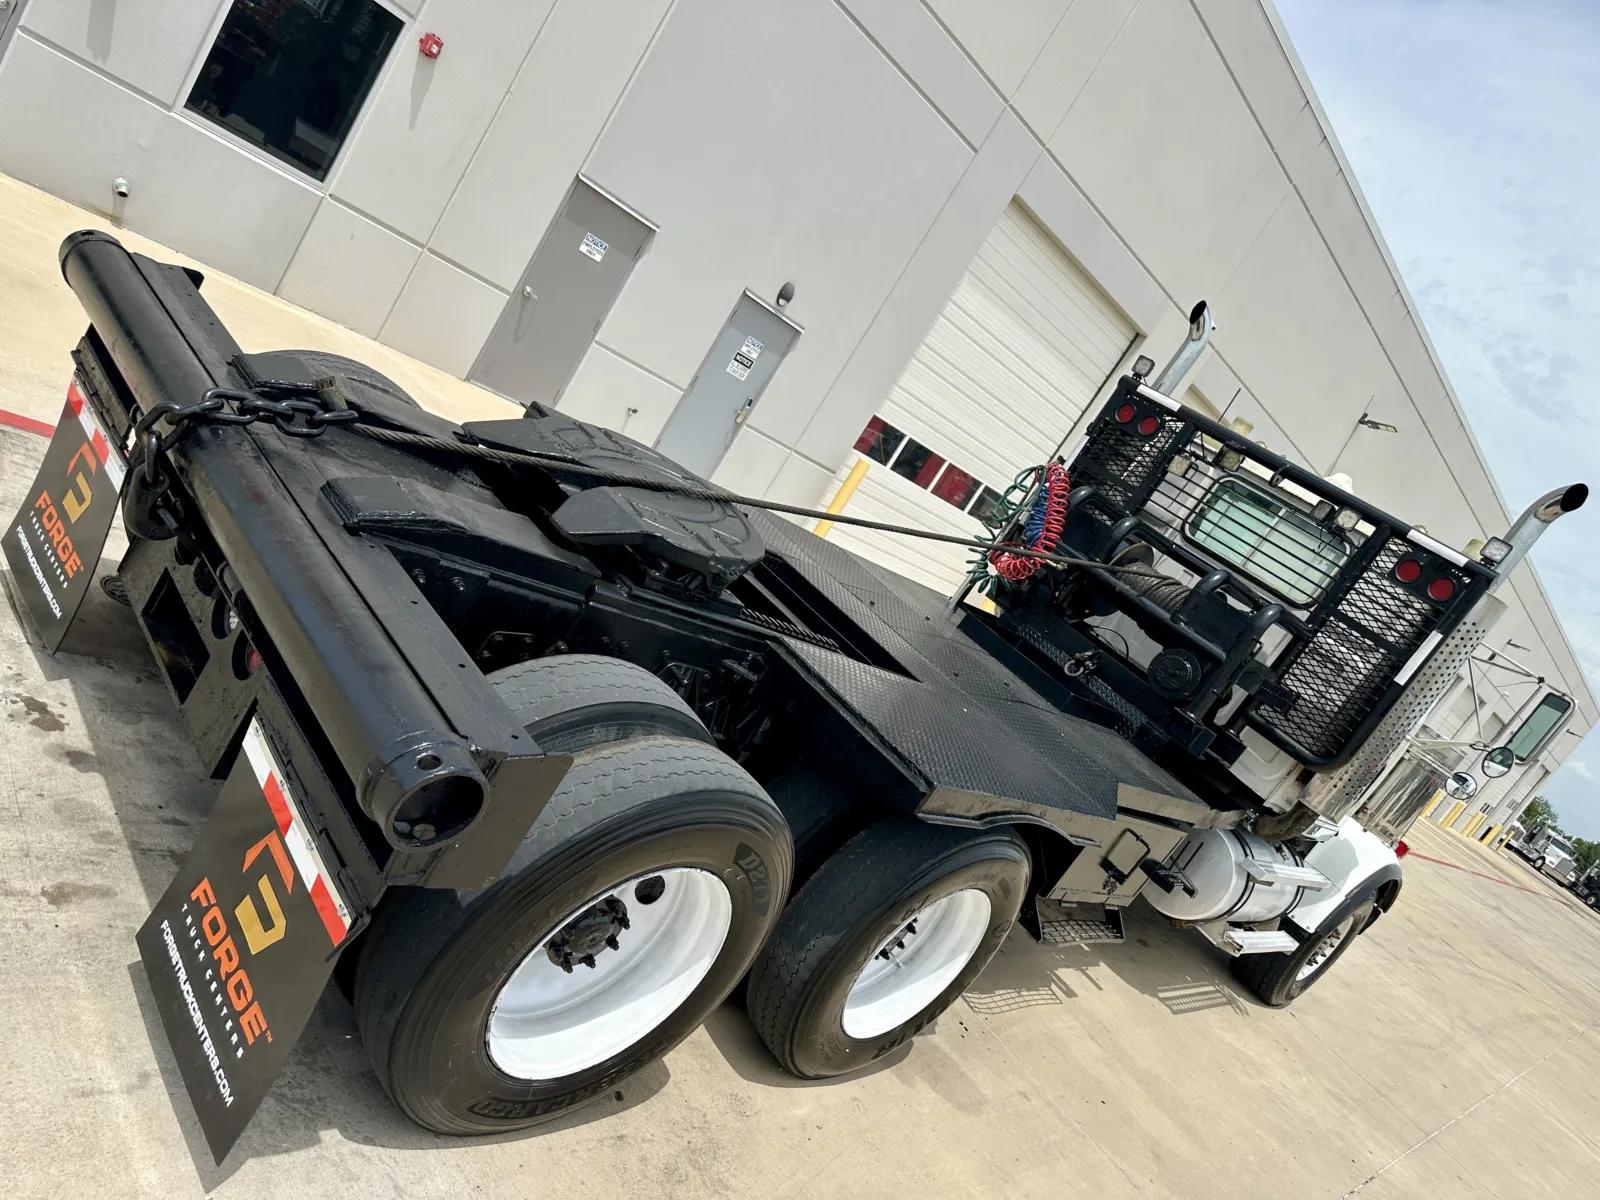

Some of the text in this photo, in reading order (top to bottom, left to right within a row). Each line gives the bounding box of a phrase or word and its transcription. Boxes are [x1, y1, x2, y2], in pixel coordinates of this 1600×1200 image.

[585, 234, 607, 251] NOTICE
[735, 354, 752, 368] NOTICE
[16, 524, 63, 620] FORGETRUCKCENTERS.COM
[29, 510, 68, 589] TRUCK CENTERS
[34, 489, 82, 579] FORGE
[181, 903, 244, 1060] TRUCK CENTERS
[190, 876, 268, 1046] FORGE
[160, 918, 234, 1108] FORGETRUCKCENTERS.COM
